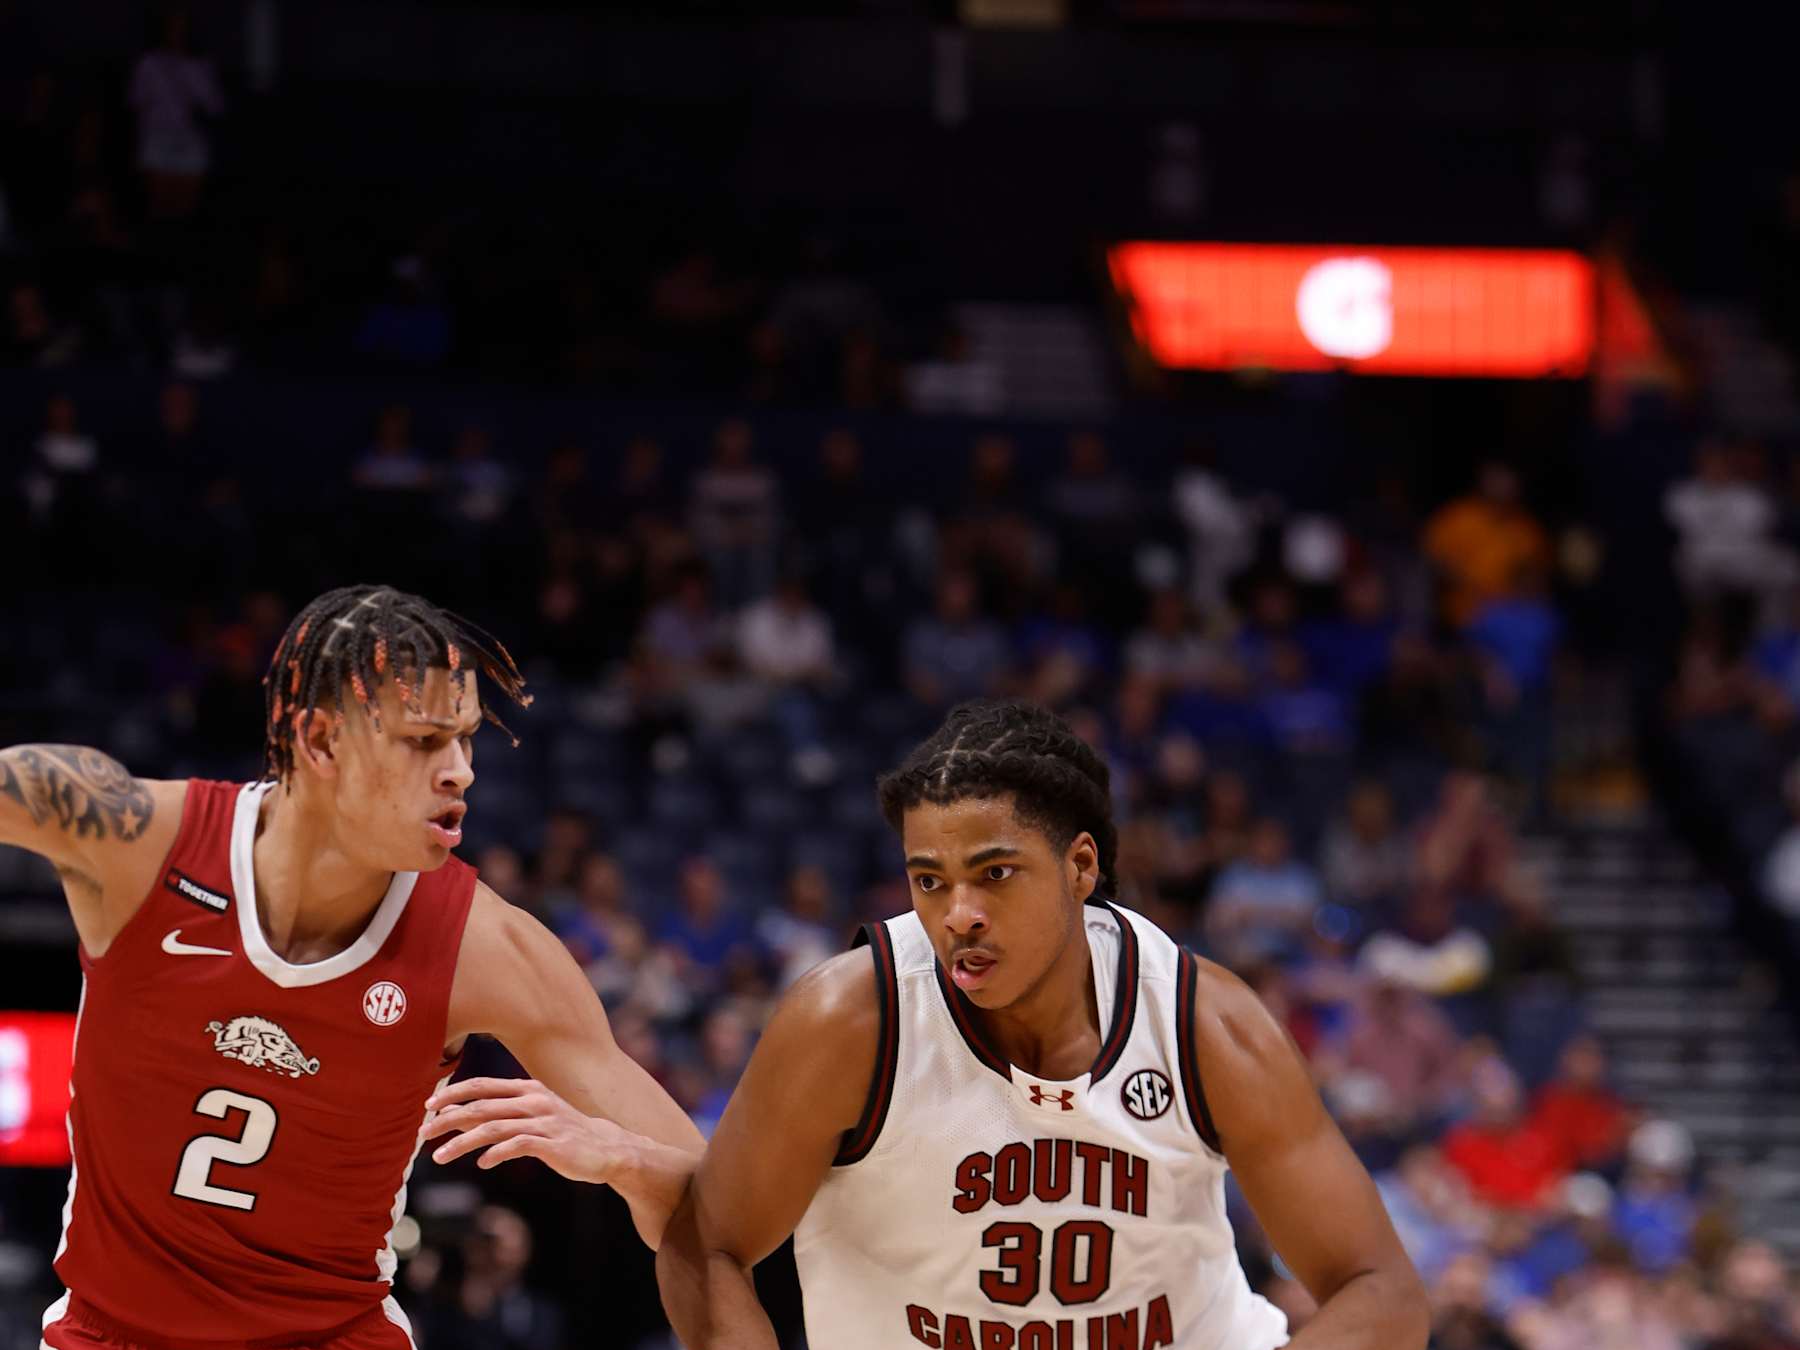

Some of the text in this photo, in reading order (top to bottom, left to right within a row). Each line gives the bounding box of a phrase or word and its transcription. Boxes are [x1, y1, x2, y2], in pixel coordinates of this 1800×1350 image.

[364, 983, 406, 1025] SEC
[1123, 1071, 1173, 1119] SEC
[172, 1088, 278, 1212] 2
[952, 1138, 1149, 1218] SOUTH
[979, 1220, 1115, 1307] 30
